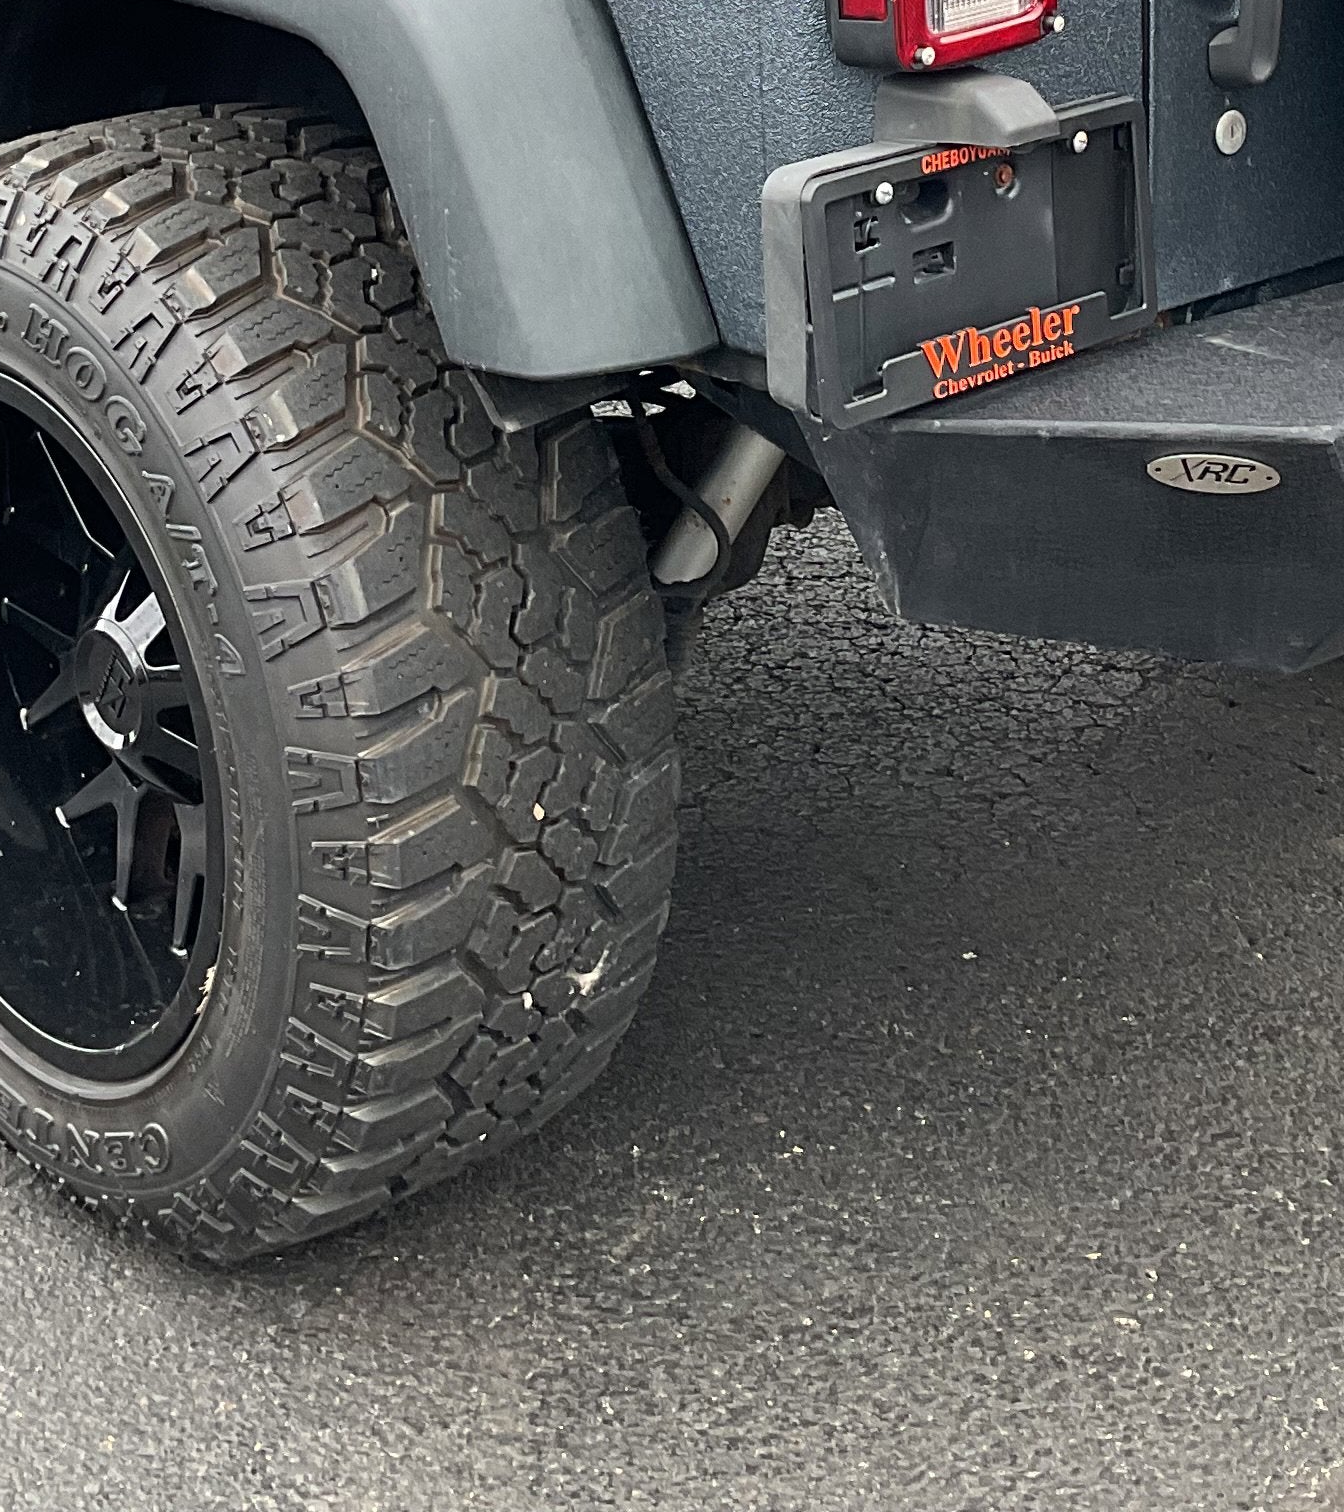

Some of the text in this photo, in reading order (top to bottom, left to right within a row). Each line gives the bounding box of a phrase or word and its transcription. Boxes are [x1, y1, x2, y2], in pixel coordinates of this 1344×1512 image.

[920, 304, 1080, 379] Wheeler
[933, 360, 1015, 399] Chevrolet
[1029, 340, 1074, 368] Buick
[20, 303, 148, 457] HOG
[1169, 458, 1256, 484] XRC
